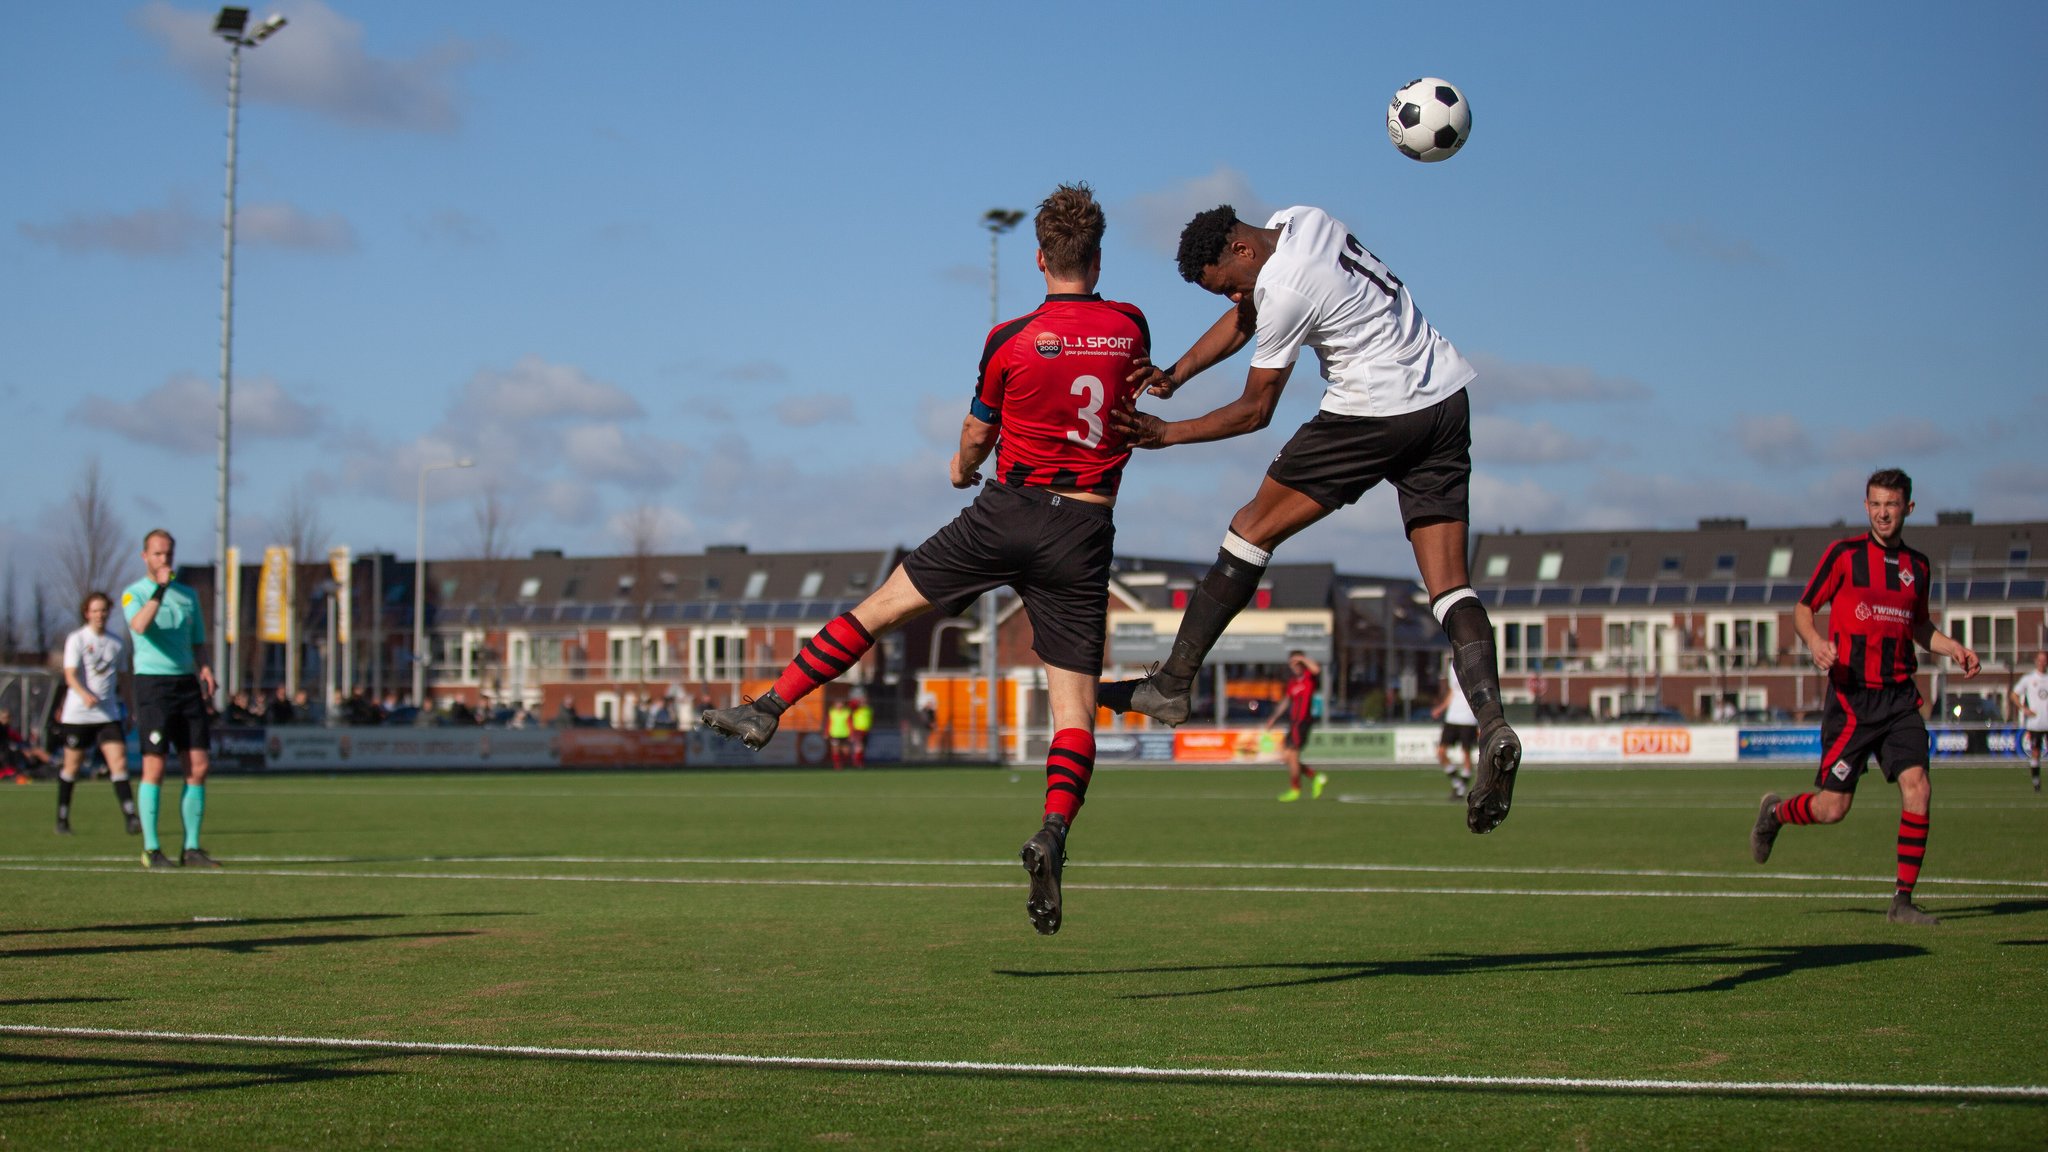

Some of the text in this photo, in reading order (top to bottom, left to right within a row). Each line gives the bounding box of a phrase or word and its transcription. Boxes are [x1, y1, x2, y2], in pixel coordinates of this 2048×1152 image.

[1063, 336, 1134, 350] L.J. SPORT
[1065, 349, 1077, 357] your
[1077, 349, 1109, 357] professional
[1066, 374, 1105, 449] 3
[1626, 733, 1688, 753] DUIN
